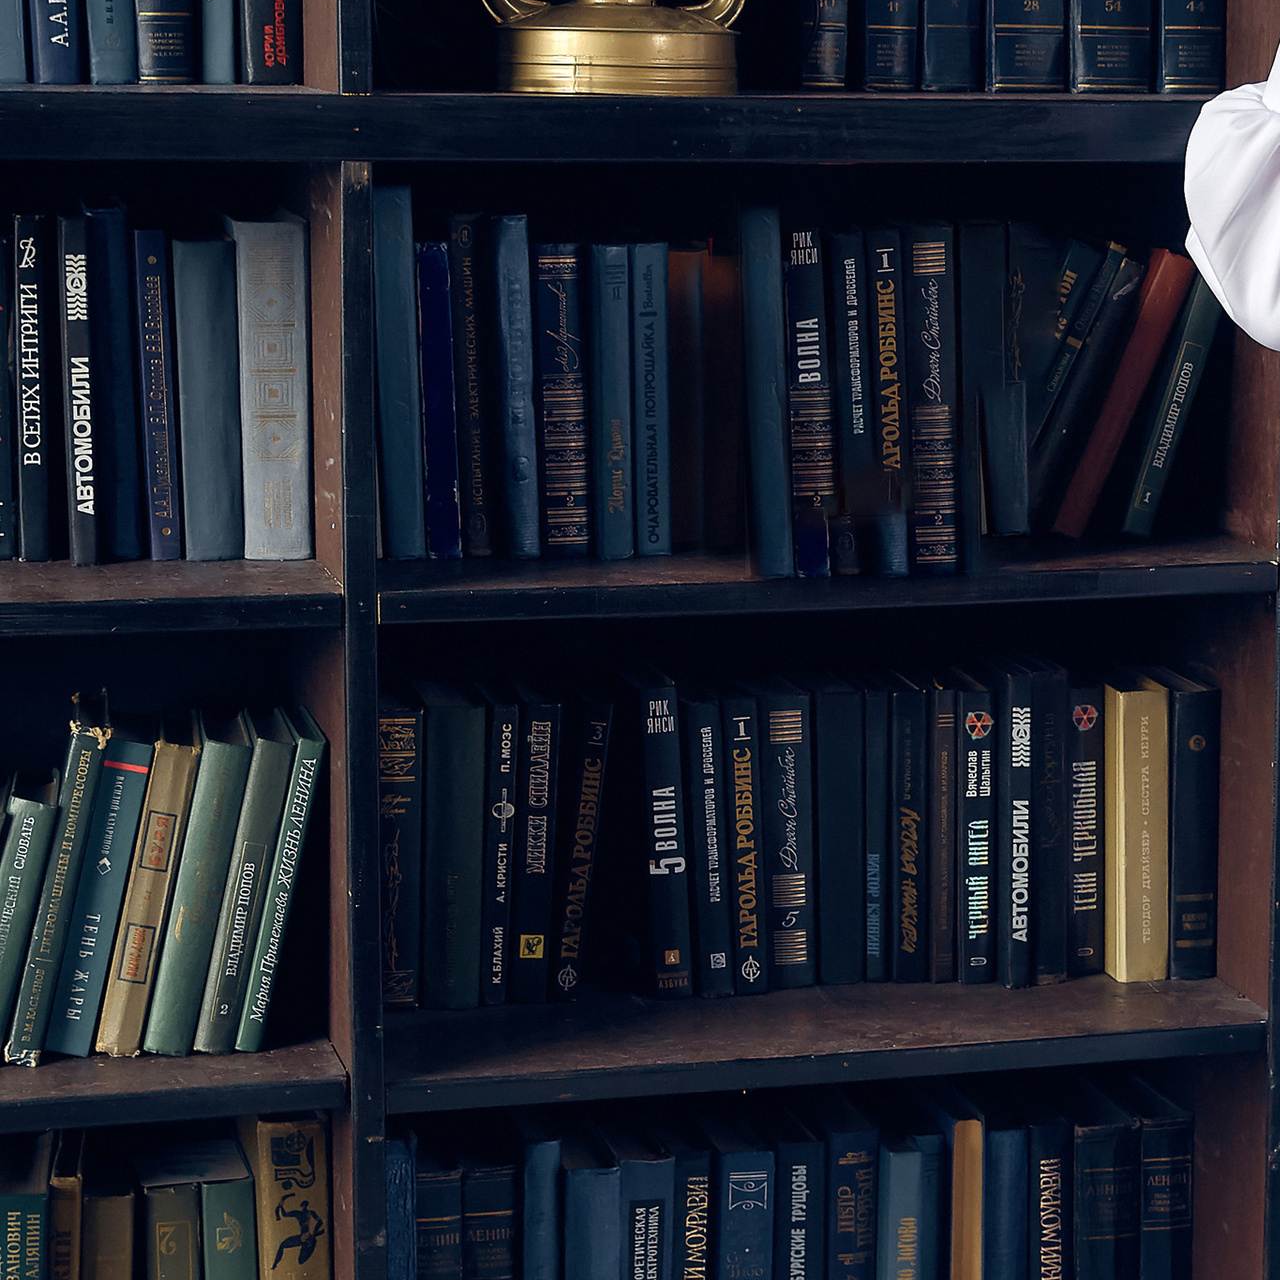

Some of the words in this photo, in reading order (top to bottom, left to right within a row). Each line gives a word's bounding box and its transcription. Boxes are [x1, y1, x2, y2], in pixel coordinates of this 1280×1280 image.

[1023, 0, 1040, 12] 28
[1104, 0, 1123, 12] 54
[1185, 1, 1206, 12] 44
[461, 256, 475, 310] МАШИН
[843, 257, 857, 306] ДРОССЕЛЕЙ
[20, 283, 40, 379] ИНТРИГИ
[845, 309, 857, 317] И
[876, 278, 898, 381] РОББИНС
[464, 313, 480, 420] ЭЛЕКТРИЧЕСКИХ
[642, 322, 657, 418] ПОПРОШАЙКА
[795, 317, 822, 383] ВОЛНА
[846, 320, 862, 402] ТРАНСФОРМАТОРОВ
[22, 383, 41, 449] СЕТЯХ
[70, 356, 95, 515] АВТОМОБИЛИ
[851, 404, 865, 434] РАСЧЕТ
[1151, 402, 1183, 469] ВЛАДИМИР
[1173, 361, 1195, 404] ПОПОВ
[24, 452, 41, 466] В
[469, 427, 484, 506] ИСПЫТАНИЕ
[644, 423, 660, 544] ОЧАРОВАТЕЛЬНАЯ
[527, 721, 552, 808] СПИЛЛЕЙН
[700, 726, 714, 774] ДРОССЕЛЕЙ
[1140, 715, 1150, 759] КЕРРИ
[61, 749, 93, 838] КОМПРЕССОРЫ
[109, 775, 125, 810] ВАСИЛИЙ
[288, 758, 317, 828] ЛЕНИНА
[703, 777, 714, 785] И
[732, 747, 754, 849] РОББИНС
[965, 750, 979, 798] Вячеслав
[978, 750, 992, 798] Шалыгин
[1140, 765, 1150, 816] СЕСТРА
[572, 757, 603, 859] РОББИНС
[651, 785, 679, 851] ВОЛНА
[703, 788, 720, 870] ТРАНСФОРМАТОРОВ
[1071, 759, 1098, 862] ЧЕРНОБЫЛЯ
[61, 841, 74, 851] И
[148, 816, 170, 868] БУРЯ
[276, 828, 302, 889] ЖИЗНЬ
[526, 815, 548, 873] МИККИ
[649, 856, 687, 875] 5
[781, 819, 799, 871] Джон
[967, 819, 990, 865] АНГЕЛ
[1011, 799, 1030, 942] АВТОМОБИЛИ
[1140, 830, 1151, 889] ДРАЙЗЕР
[38, 852, 72, 954] ГИДРОМАШИНЫ
[560, 863, 591, 959] ГАРОЛЬД
[709, 872, 722, 902] РАСЧЕТ
[734, 851, 759, 949] ГАРОЛЬД
[965, 875, 990, 940] ЧЕРНЫЙ
[1072, 871, 1098, 914] ТЕНИ
[79, 913, 102, 958] ТЕНЬ
[225, 907, 249, 976] ВЛАДИМИР
[237, 862, 256, 906] ПОПОВ
[260, 891, 289, 974] Прилежаева
[1141, 894, 1151, 944] ТЕОДОР
[66, 969, 89, 1020] ЖАРЫ
[219, 1003, 230, 1015] 2
[249, 975, 273, 1023] Мария
[684, 1180, 709, 1264] МОУРАВИ
[791, 1164, 809, 1222] ТРУЩОБЫ
[1038, 1163, 1063, 1243] МОУРАВИ
[160, 1226, 178, 1255] 2
